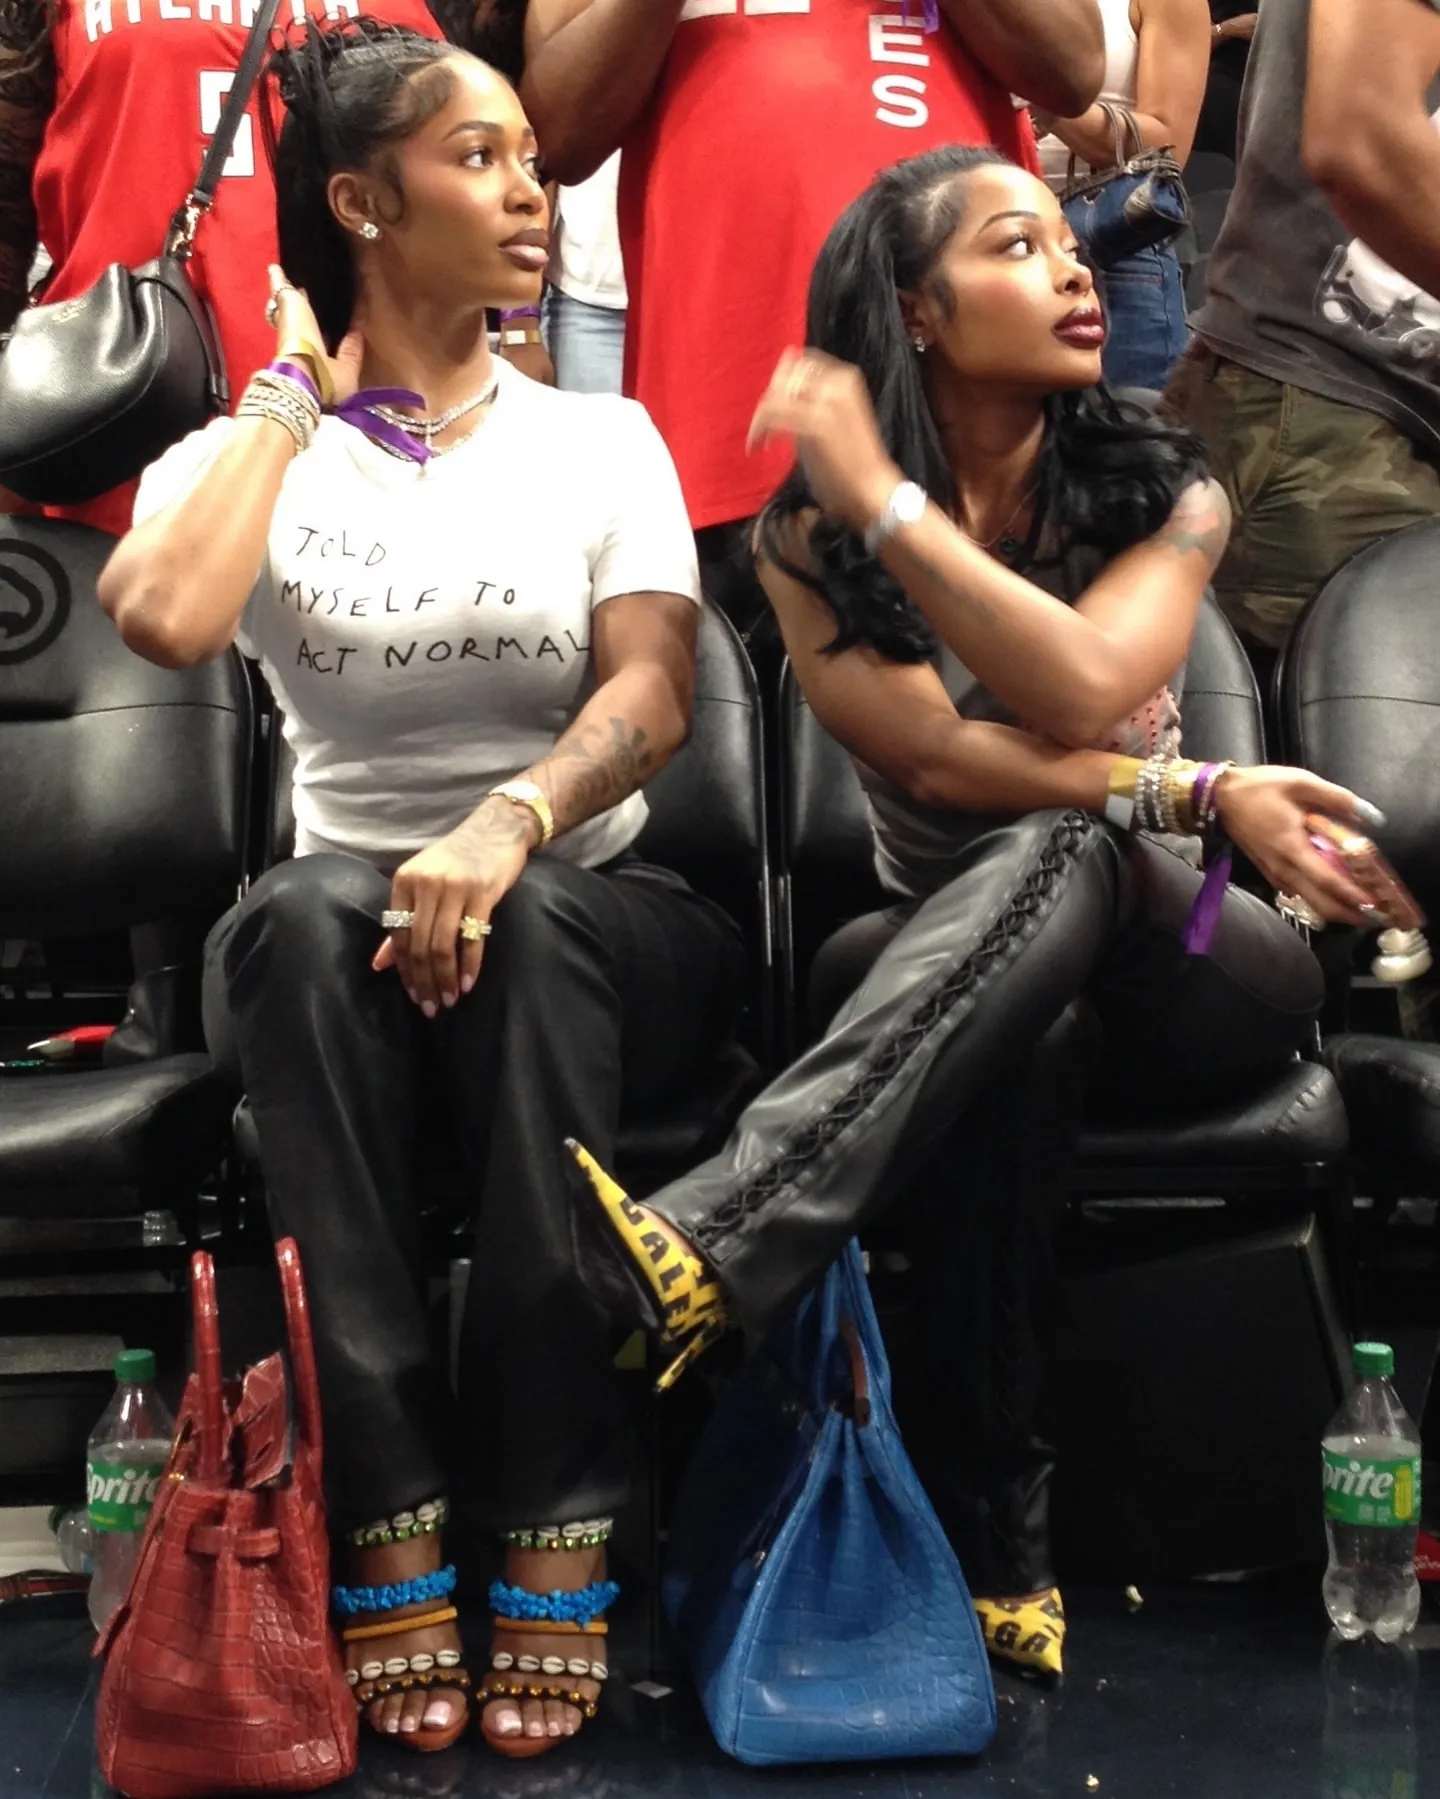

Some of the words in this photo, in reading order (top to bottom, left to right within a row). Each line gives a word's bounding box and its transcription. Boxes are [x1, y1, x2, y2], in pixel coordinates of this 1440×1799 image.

[868, 0, 930, 128] ES
[296, 526, 387, 566] TOLD
[280, 579, 440, 617] MYSELF
[475, 580, 516, 606] TO
[297, 638, 358, 675] ACT
[384, 629, 592, 668] NORMAL
[87, 1462, 163, 1505] prit
[1321, 1450, 1394, 1499] prite
